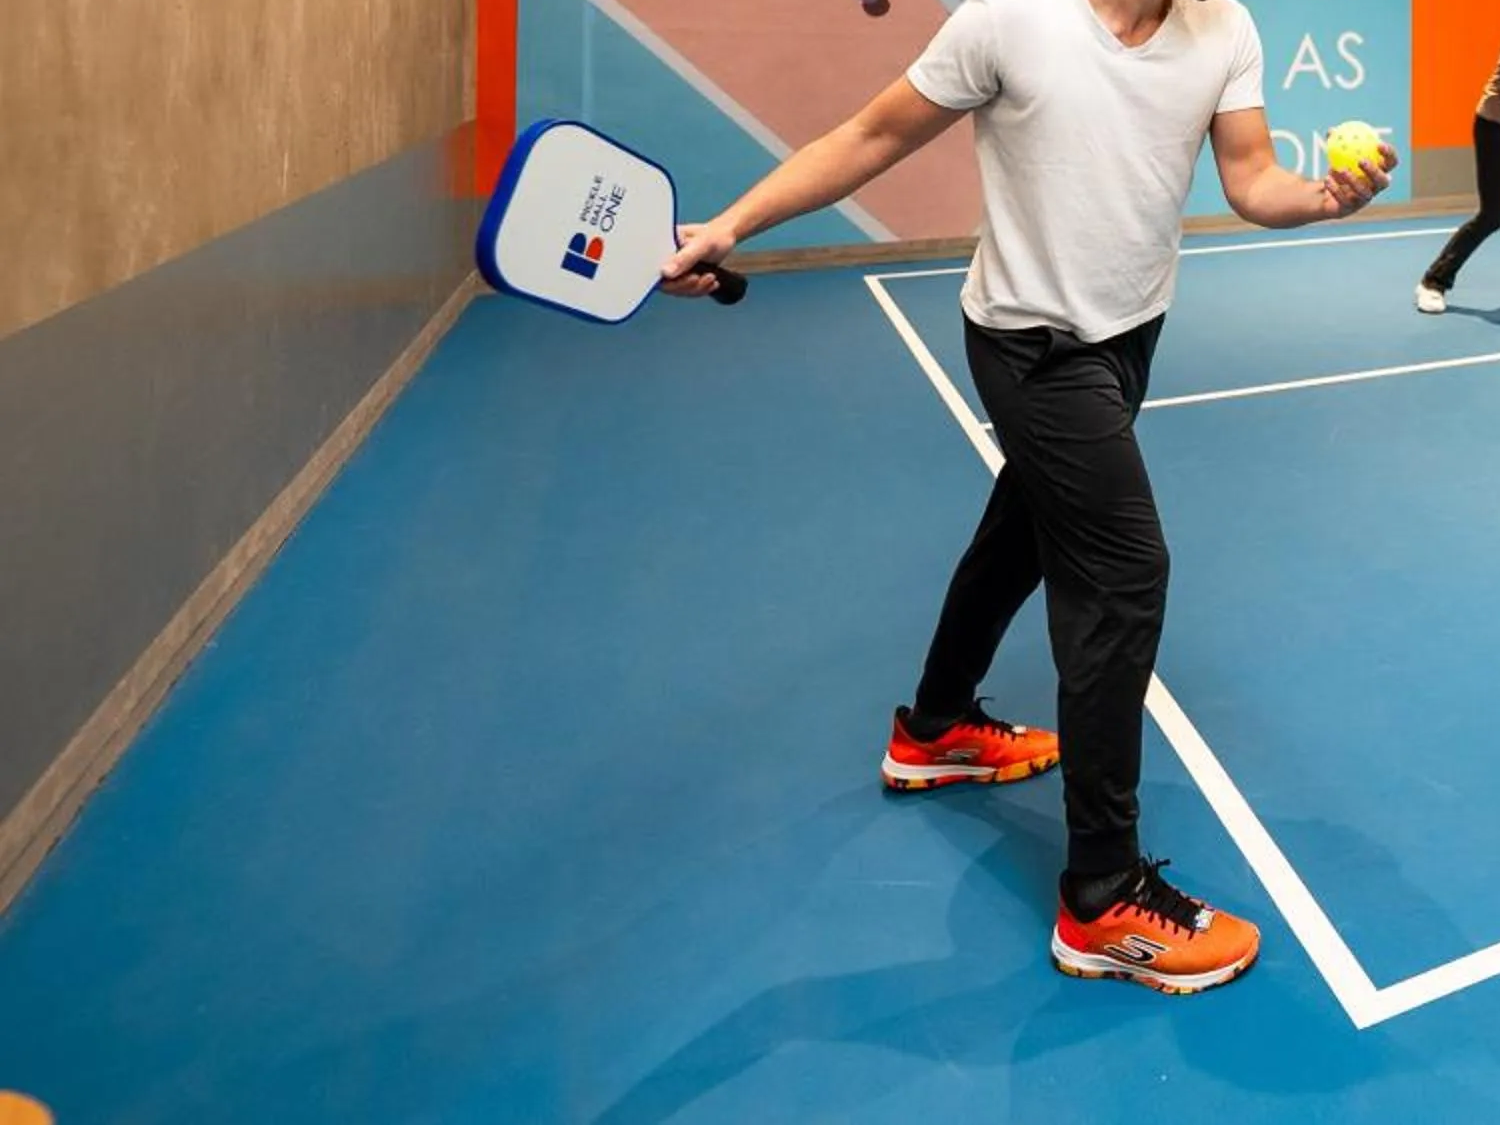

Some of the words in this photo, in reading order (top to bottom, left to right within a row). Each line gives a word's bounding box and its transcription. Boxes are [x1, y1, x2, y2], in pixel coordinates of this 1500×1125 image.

[1282, 32, 1365, 90] AS
[579, 175, 603, 223] PICKLE
[589, 193, 608, 226] BALL
[600, 183, 627, 233] ONE
